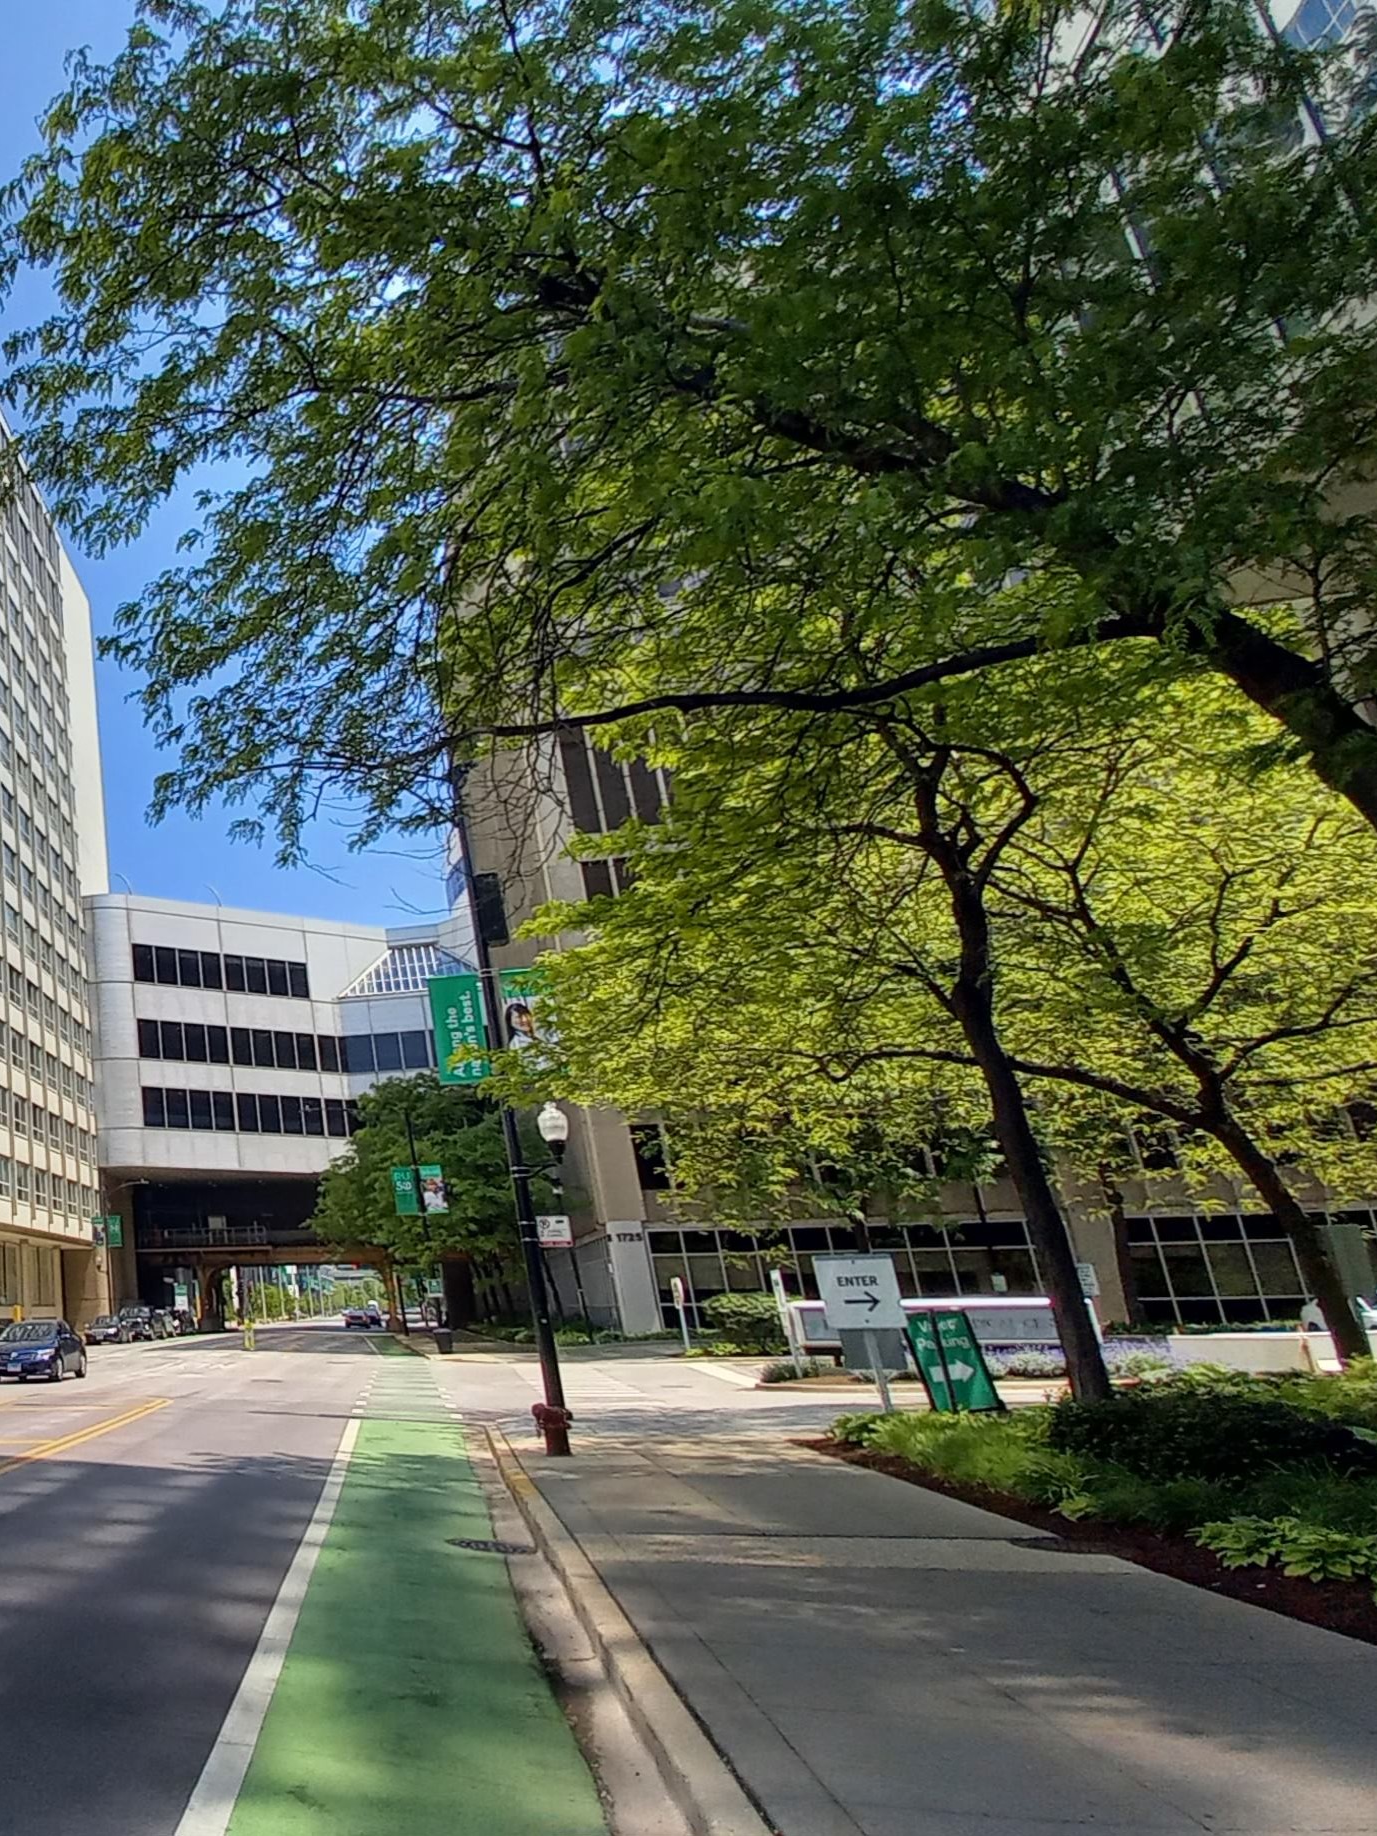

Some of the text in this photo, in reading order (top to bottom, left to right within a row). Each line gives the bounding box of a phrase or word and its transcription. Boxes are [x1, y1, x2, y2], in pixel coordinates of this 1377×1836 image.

[459, 990, 475, 1023] best.
[445, 1007, 459, 1029] the
[616, 1232, 643, 1243] 1725
[836, 1275, 879, 1287] ENTER
